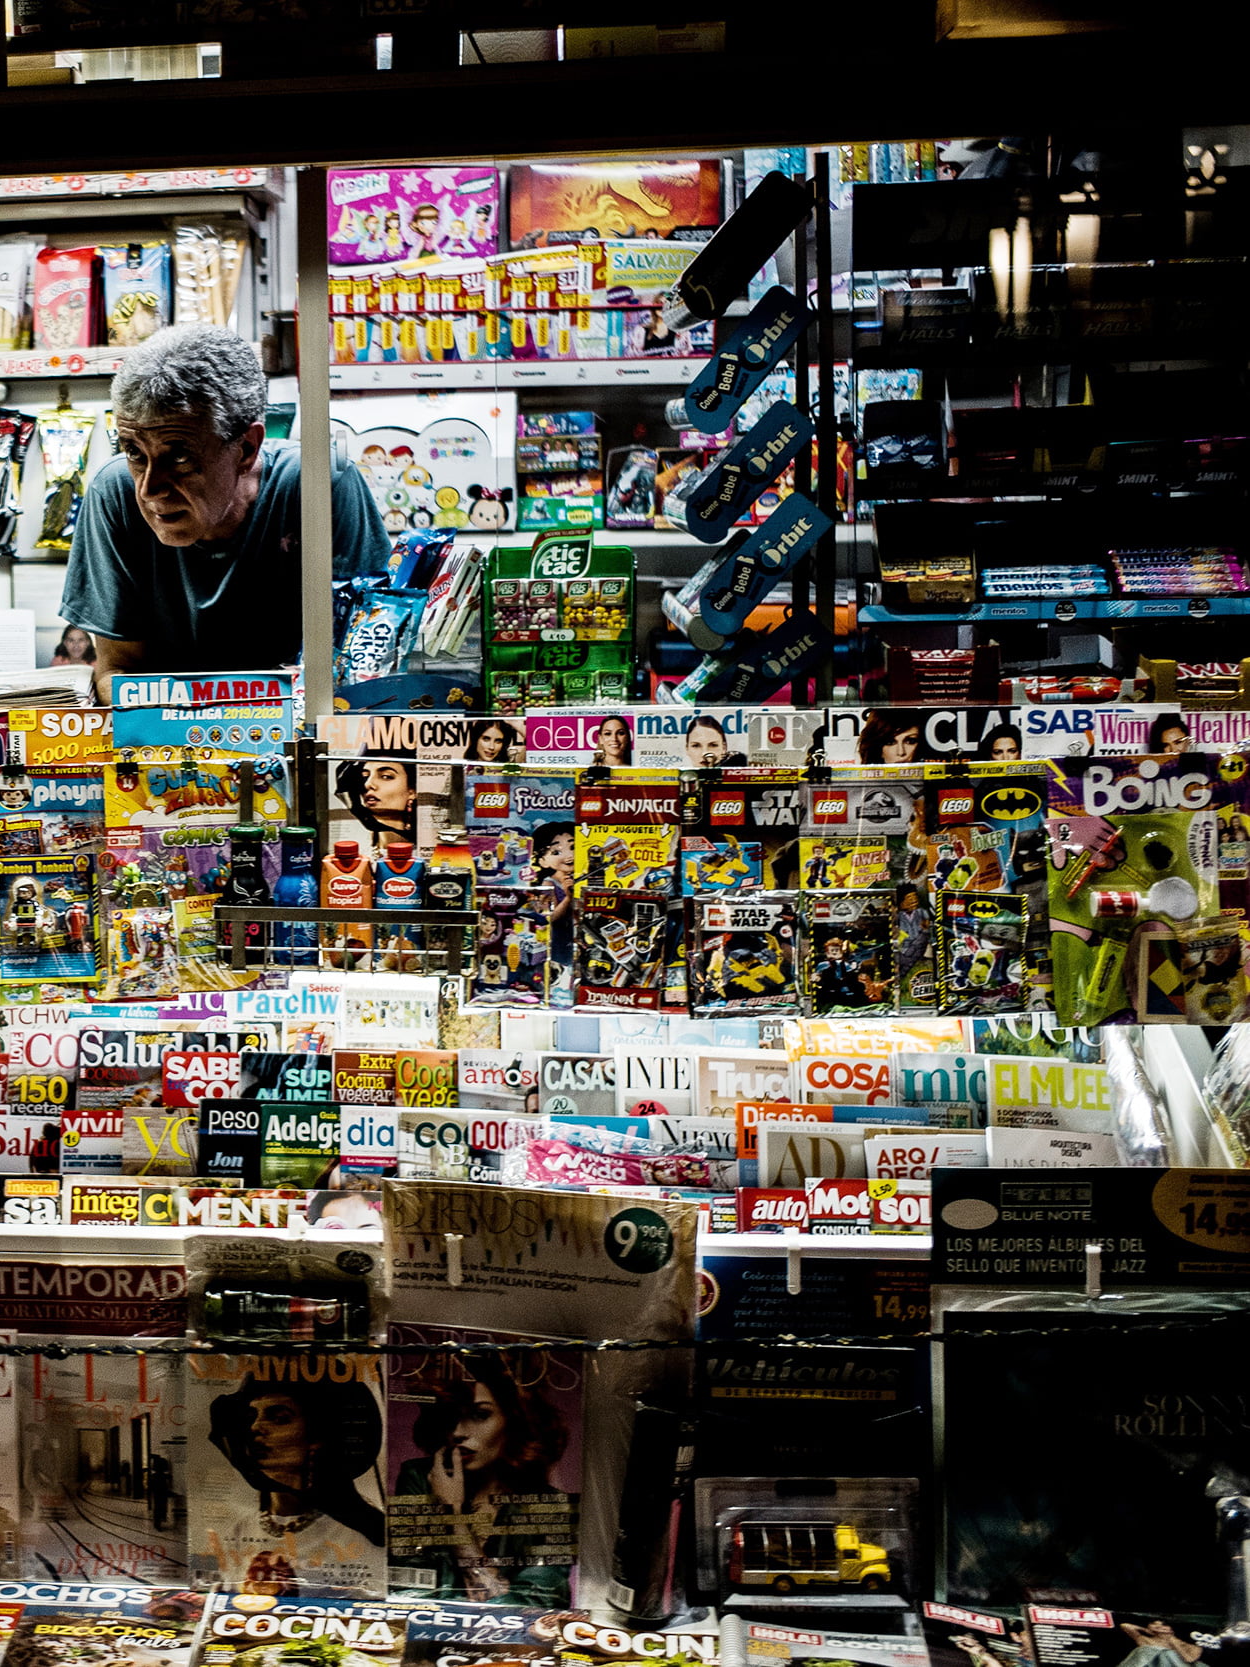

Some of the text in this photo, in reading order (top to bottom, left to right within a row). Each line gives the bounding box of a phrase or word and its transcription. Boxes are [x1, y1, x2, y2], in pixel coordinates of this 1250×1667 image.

[552, 545, 581, 561] tic
[542, 560, 579, 578] tac
[119, 677, 282, 707] GUÍA MARCA
[33, 743, 79, 764] 5000
[711, 800, 742, 815] LEGO
[815, 800, 845, 814] LEGO
[940, 798, 972, 814] LEGO
[633, 850, 664, 863] COLE
[731, 908, 769, 918] STAR
[732, 917, 770, 927] WARS
[336, 1071, 387, 1089] Cocina
[13, 1076, 68, 1104] 150
[12, 1102, 65, 1118] recetas
[638, 1102, 657, 1116] 24
[209, 1110, 260, 1136] peso
[347, 1117, 395, 1147] dia
[208, 1152, 244, 1168] Jon
[770, 1137, 847, 1189] AD
[946, 1238, 971, 1253] LOS
[977, 1238, 1043, 1254] MEJORES
[1119, 1238, 1146, 1254] DEL
[946, 1258, 989, 1274] SELLO
[993, 1258, 1021, 1274] QUE
[1113, 1258, 1146, 1274] JAZZ
[34, 1623, 177, 1640] BIZCOCHOS
[212, 1613, 396, 1645] COCINA
